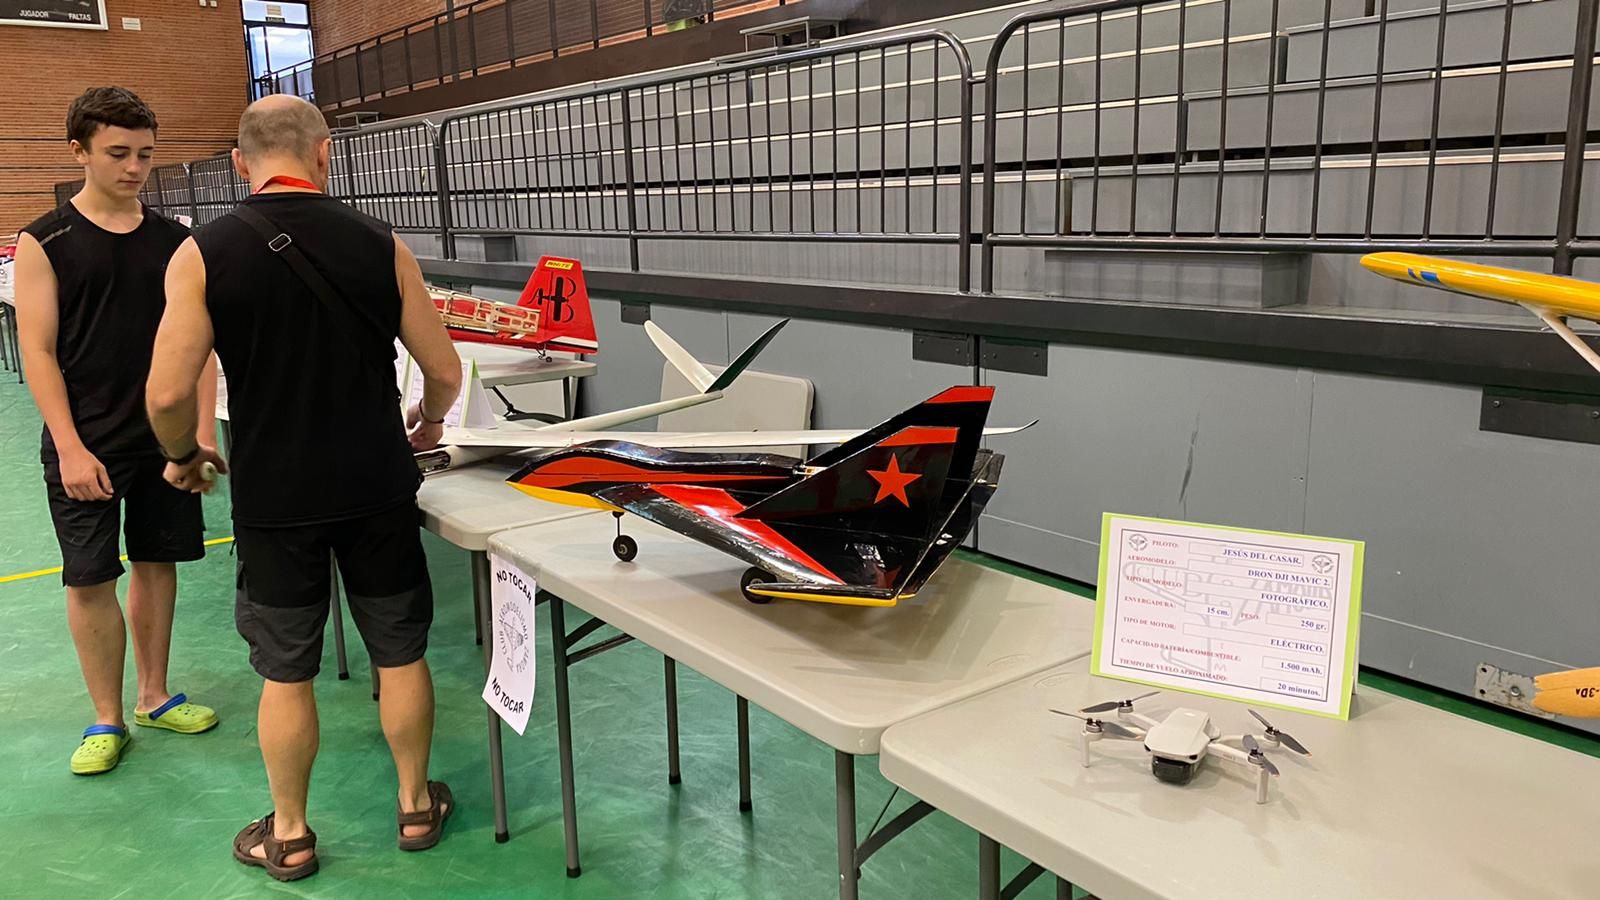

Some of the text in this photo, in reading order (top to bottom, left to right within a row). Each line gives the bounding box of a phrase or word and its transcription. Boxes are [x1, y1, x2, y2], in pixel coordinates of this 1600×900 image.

[20, 10, 92, 21] JUGADOR FALTAS
[1152, 540, 1178, 548] PILOTO:
[1128, 555, 1176, 565] AEROMODELO:
[1223, 548, 1248, 558] JESÚS
[1250, 552, 1268, 560] DEL
[1269, 555, 1302, 564] CASAR.
[1248, 569, 1330, 586] DRON DJI MAVIC 2.
[496, 570, 532, 605] NO TOCAR
[1124, 596, 1176, 609] ENVERGADURA:
[1261, 593, 1329, 608] FOTOGRÁFICO.
[1150, 620, 1176, 630] MOTOR:
[1315, 623, 1327, 631] gr.
[1120, 637, 1159, 648] CAPACIDAD
[1270, 638, 1325, 653] ELÉCTRICO.
[1120, 658, 1145, 668] TIEMPO
[1156, 664, 1179, 673] VUELO
[1280, 661, 1323, 675] 1.500 mAh.
[492, 676, 524, 714] NO TOCAR
[1278, 682, 1321, 696] 20 minutos.
